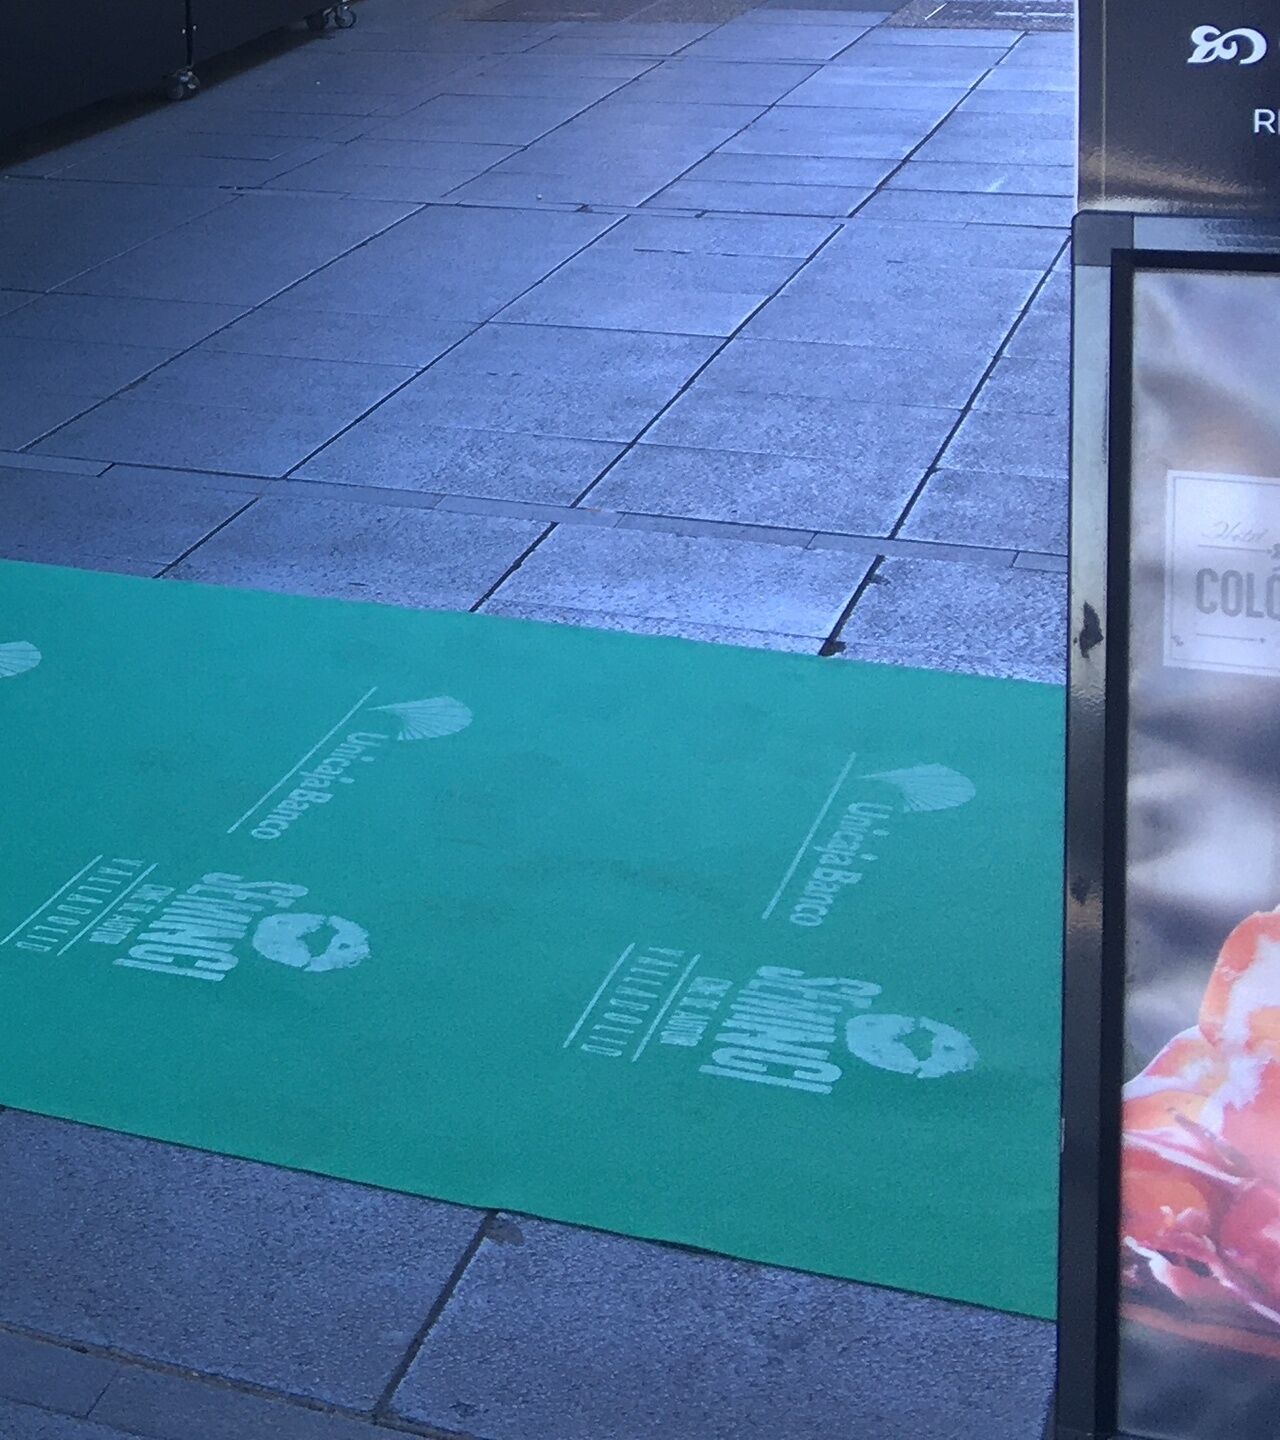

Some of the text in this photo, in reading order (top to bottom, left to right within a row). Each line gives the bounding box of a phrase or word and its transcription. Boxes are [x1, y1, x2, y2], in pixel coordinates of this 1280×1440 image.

[250, 731, 390, 840] Unicaja Banco
[15, 857, 144, 953] VALLADOLID
[112, 870, 310, 982] SEMINCI
[698, 964, 883, 1095] SEMINCI
